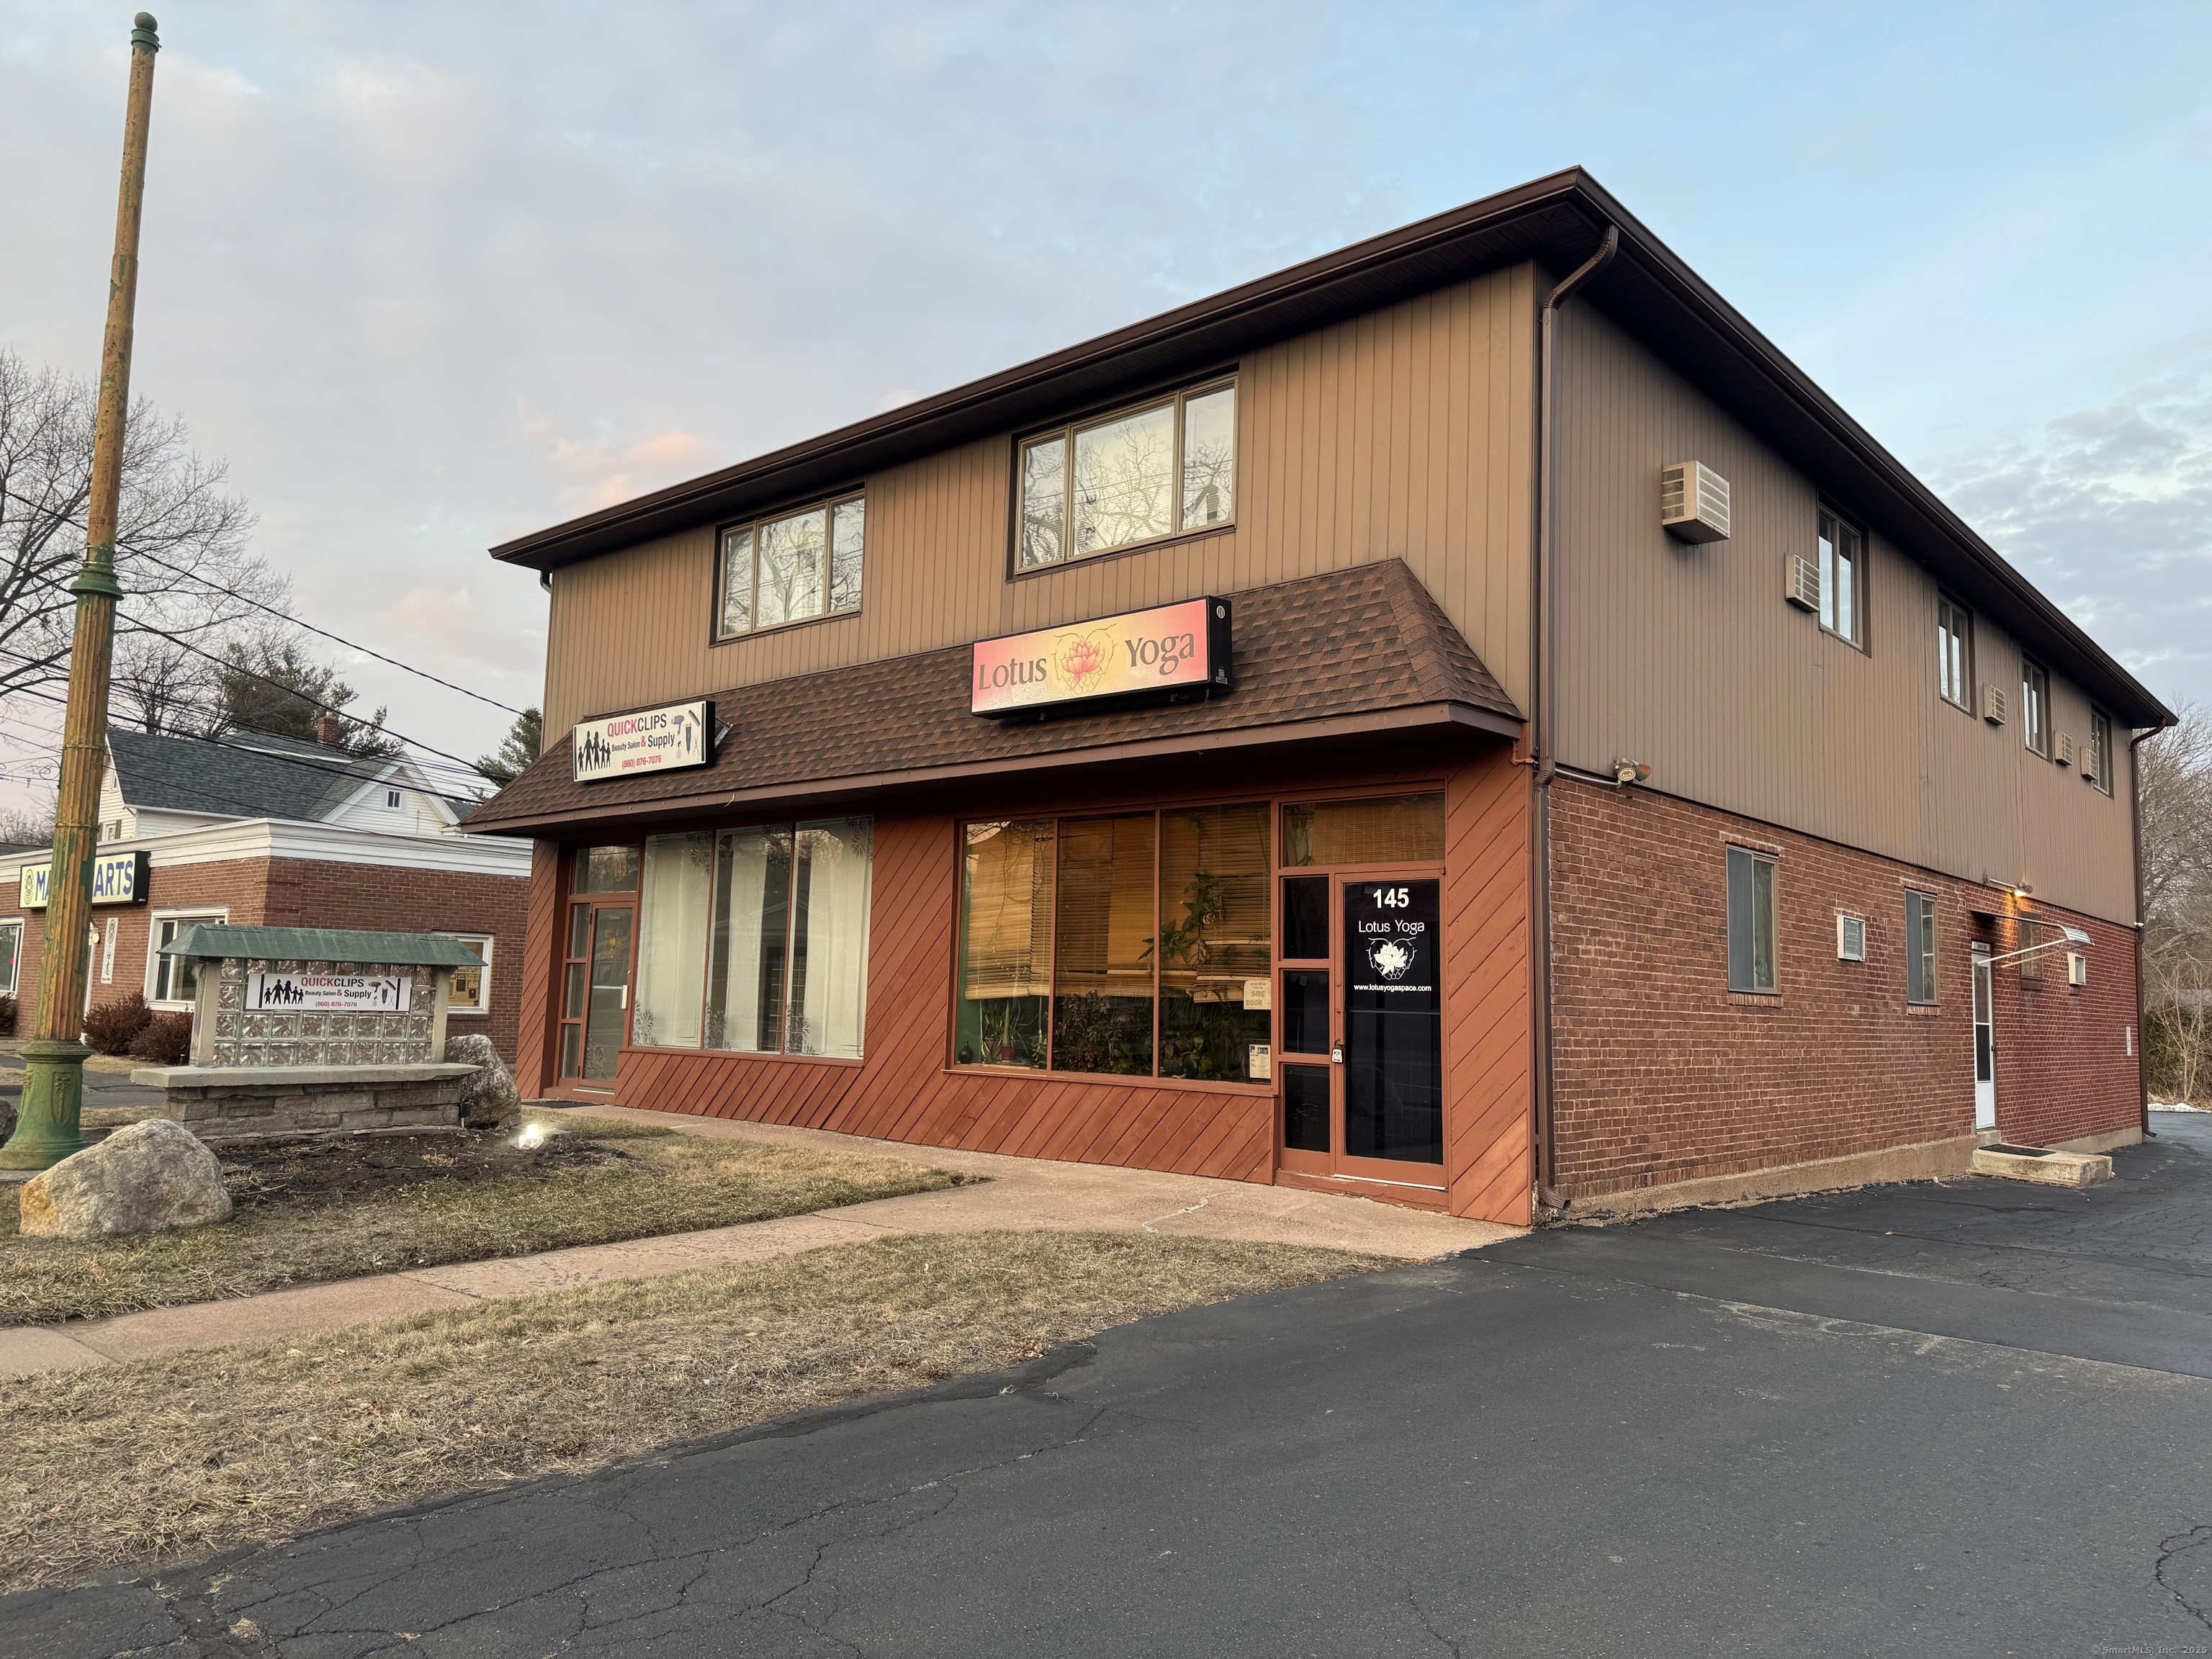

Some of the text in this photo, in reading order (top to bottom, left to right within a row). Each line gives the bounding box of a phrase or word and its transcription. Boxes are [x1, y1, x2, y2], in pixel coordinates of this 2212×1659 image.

[979, 633, 1195, 690] Lotus Yoga
[608, 714, 667, 737] QUICKCLIPS
[611, 732, 675, 752] Beauty Salon & Supply
[637, 755, 662, 766] 876-7076
[94, 860, 133, 897] ARTS
[1373, 888, 1409, 909] 145
[1358, 919, 1424, 935] Lotus Yoga
[301, 977, 364, 987] QUICKCLIPS
[1354, 984, 1431, 993] www.lotusyogaspace.com
[344, 989, 372, 999] Supply
